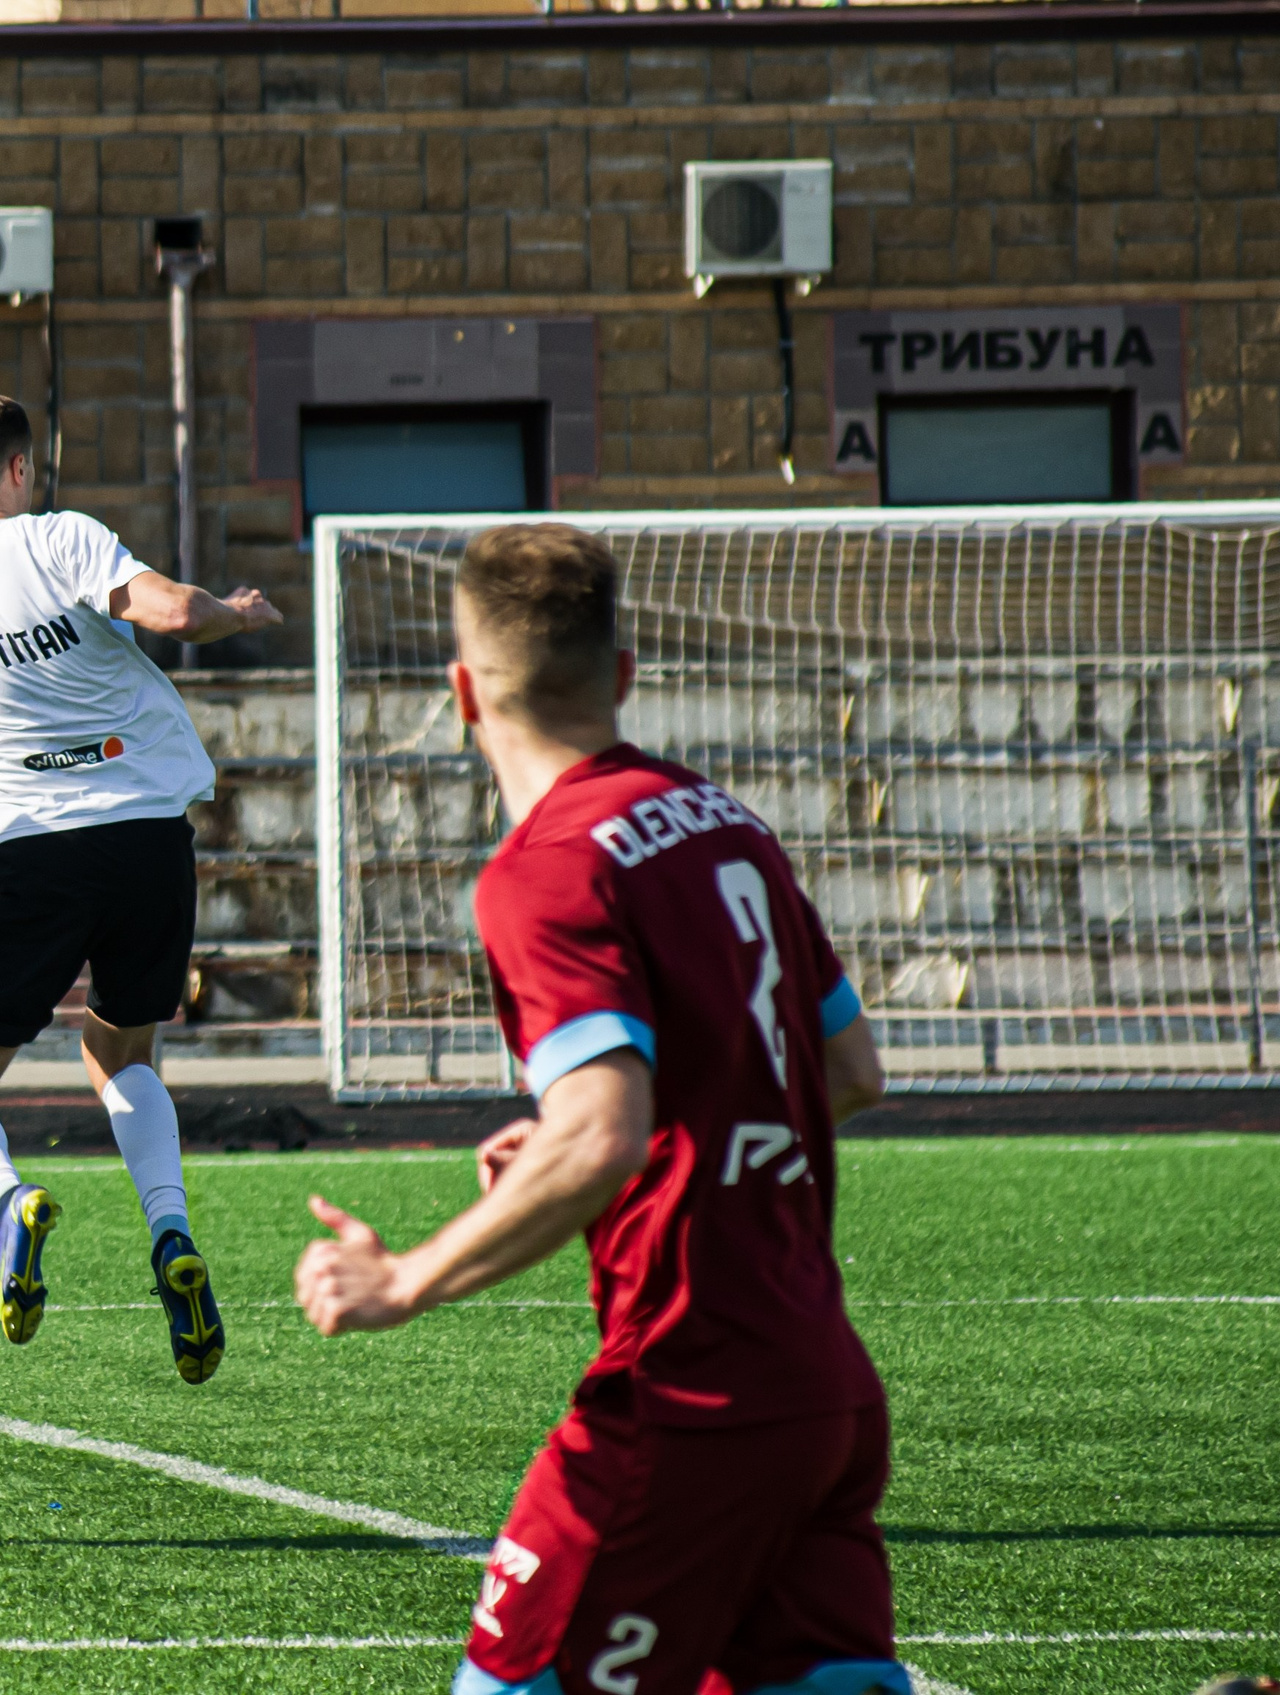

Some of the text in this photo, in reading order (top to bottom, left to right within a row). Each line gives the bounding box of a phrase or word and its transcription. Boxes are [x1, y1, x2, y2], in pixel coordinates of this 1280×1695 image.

[859, 325, 1155, 374] ТРИБУНА
[835, 420, 876, 464] А
[1140, 411, 1181, 454] А
[29, 751, 98, 769] winline
[716, 858, 788, 1090] 2
[588, 1614, 660, 1695] 2
